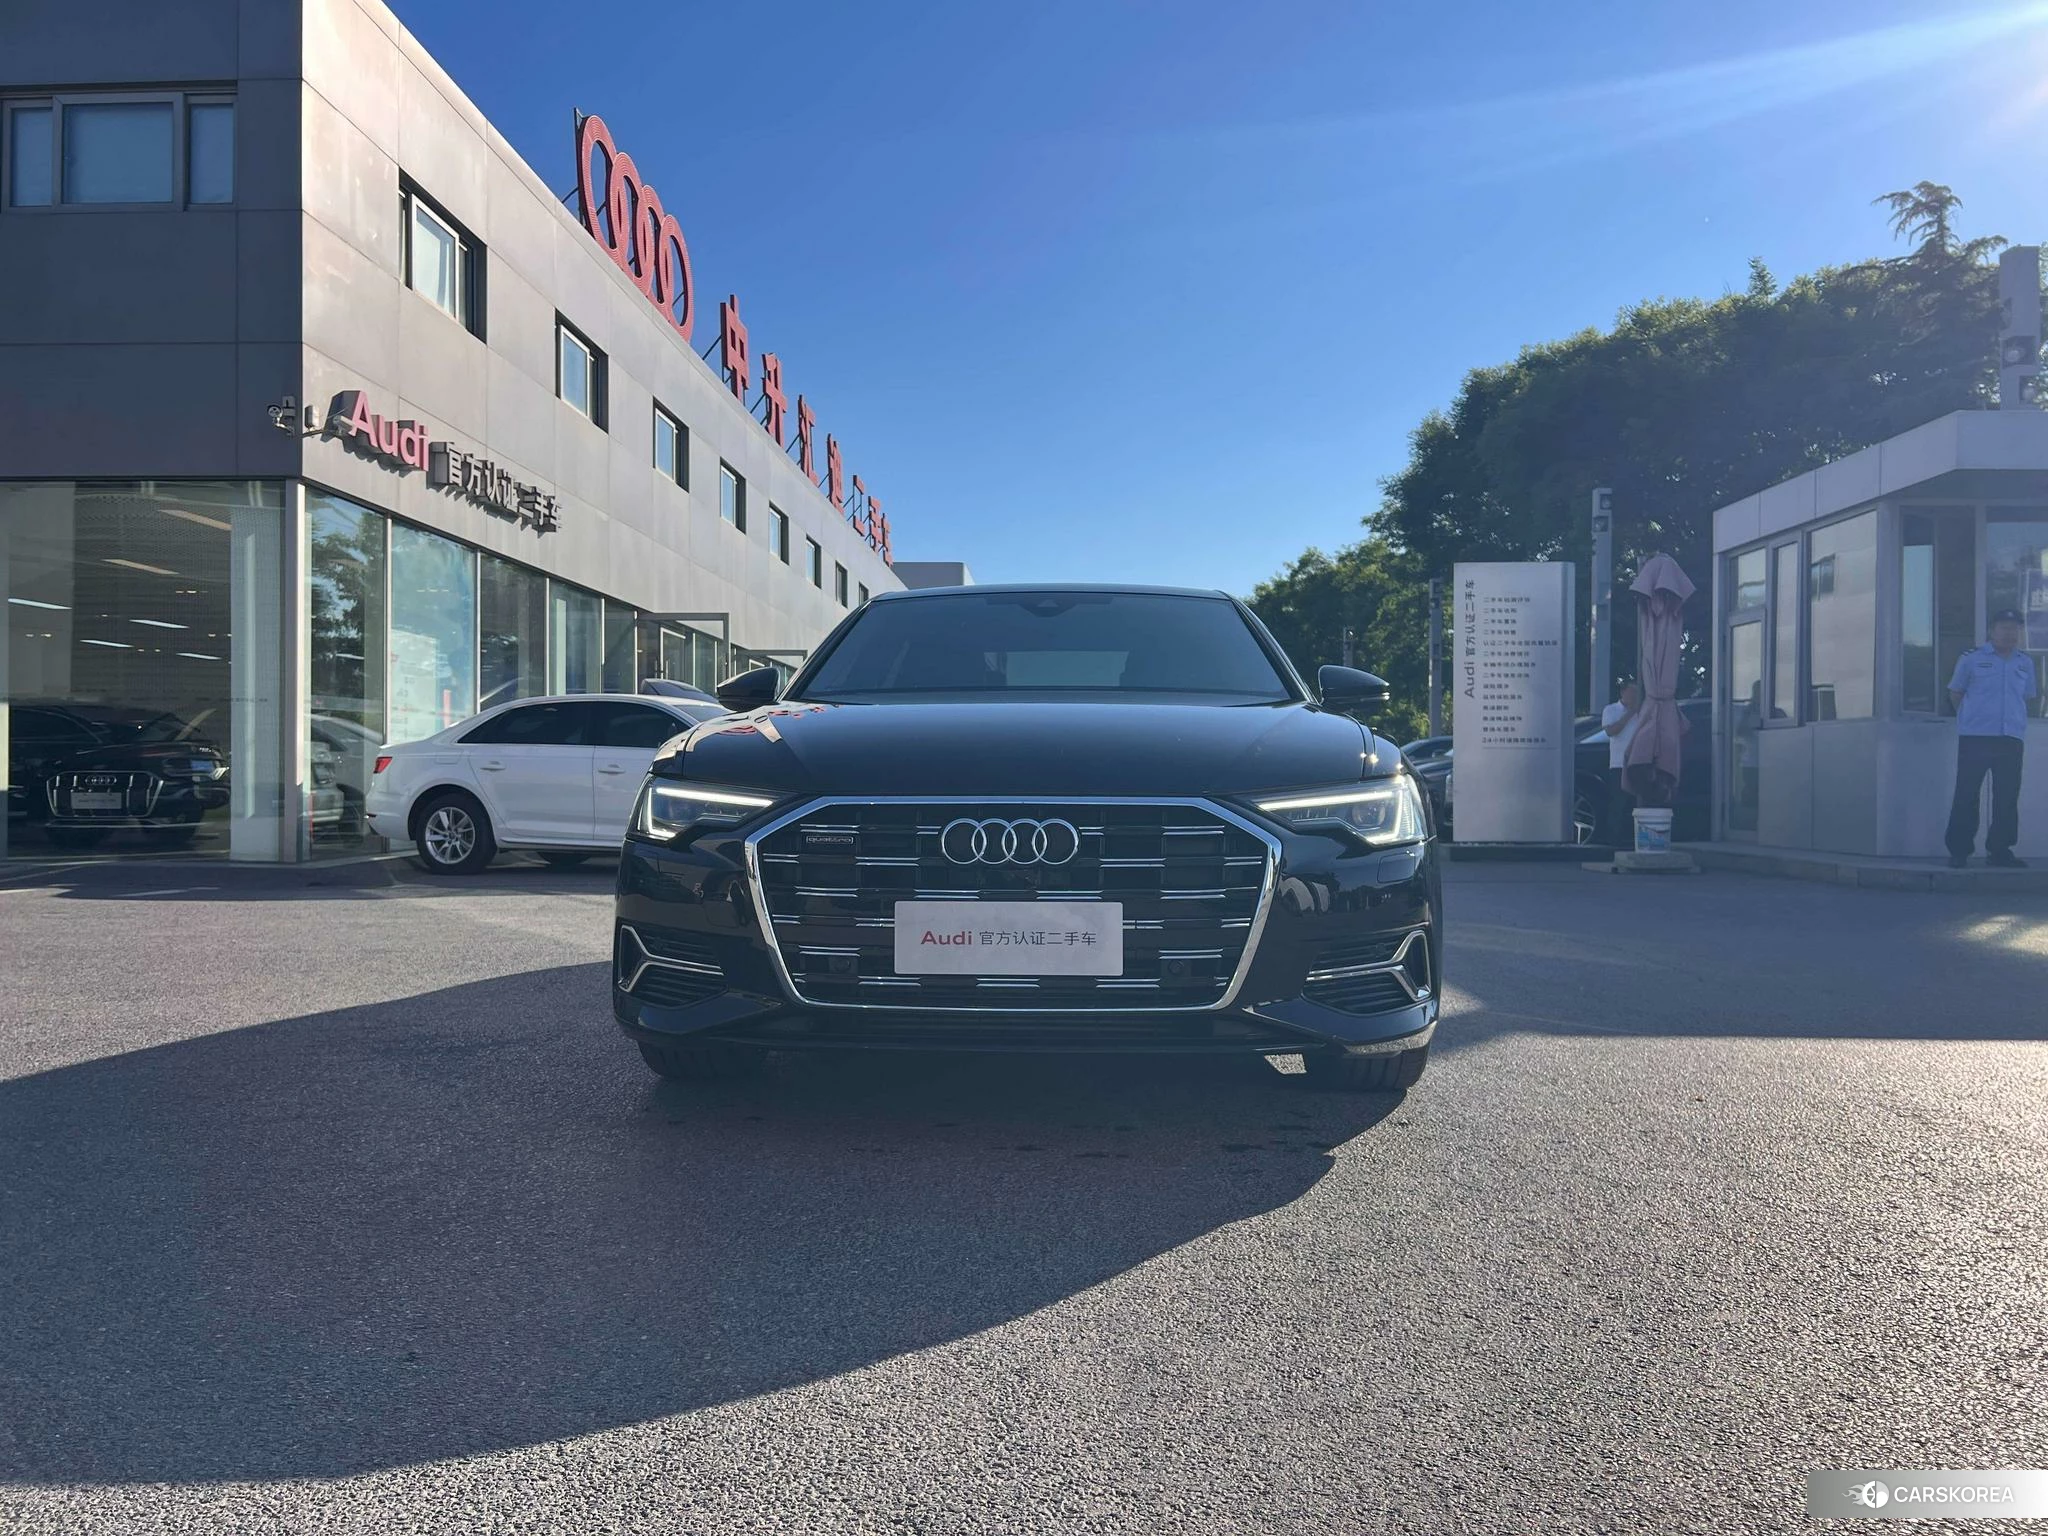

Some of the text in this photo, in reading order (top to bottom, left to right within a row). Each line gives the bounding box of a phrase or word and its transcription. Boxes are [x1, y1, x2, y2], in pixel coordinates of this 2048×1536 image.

[349, 390, 429, 472] Audi
[1464, 579, 1476, 699] Audi 官方认证二手车
[920, 930, 1097, 946] Audi 官方认证二手车
